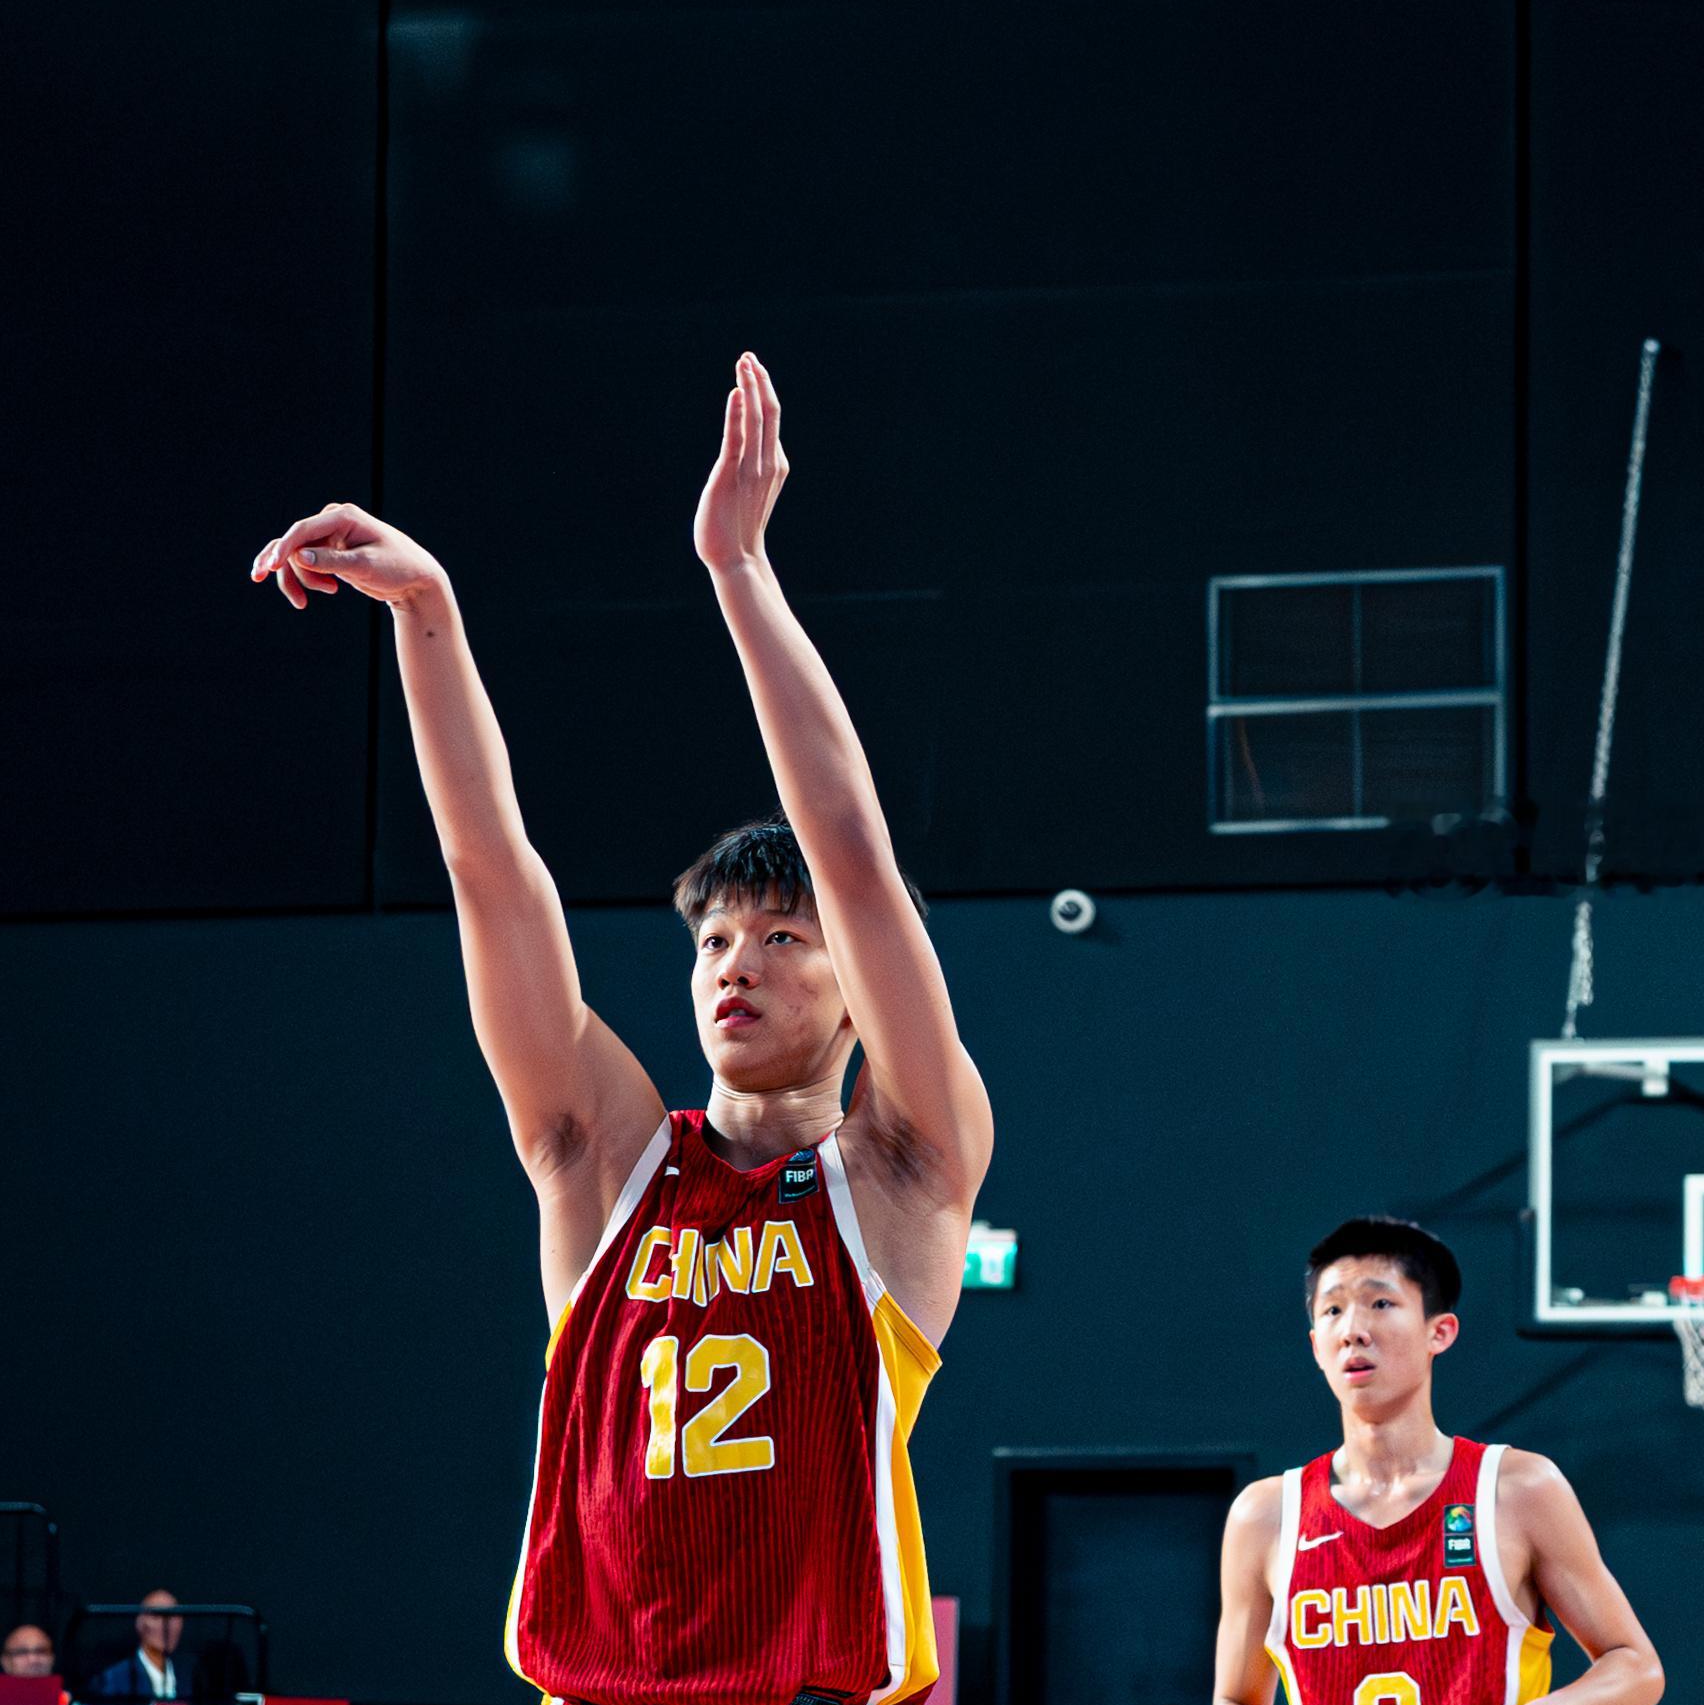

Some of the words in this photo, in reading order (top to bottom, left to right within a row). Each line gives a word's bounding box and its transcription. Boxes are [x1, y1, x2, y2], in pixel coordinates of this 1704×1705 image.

[785, 1168, 815, 1184] FIBA
[640, 1332, 775, 1480] 12
[1291, 1576, 1481, 1650] CHINA
